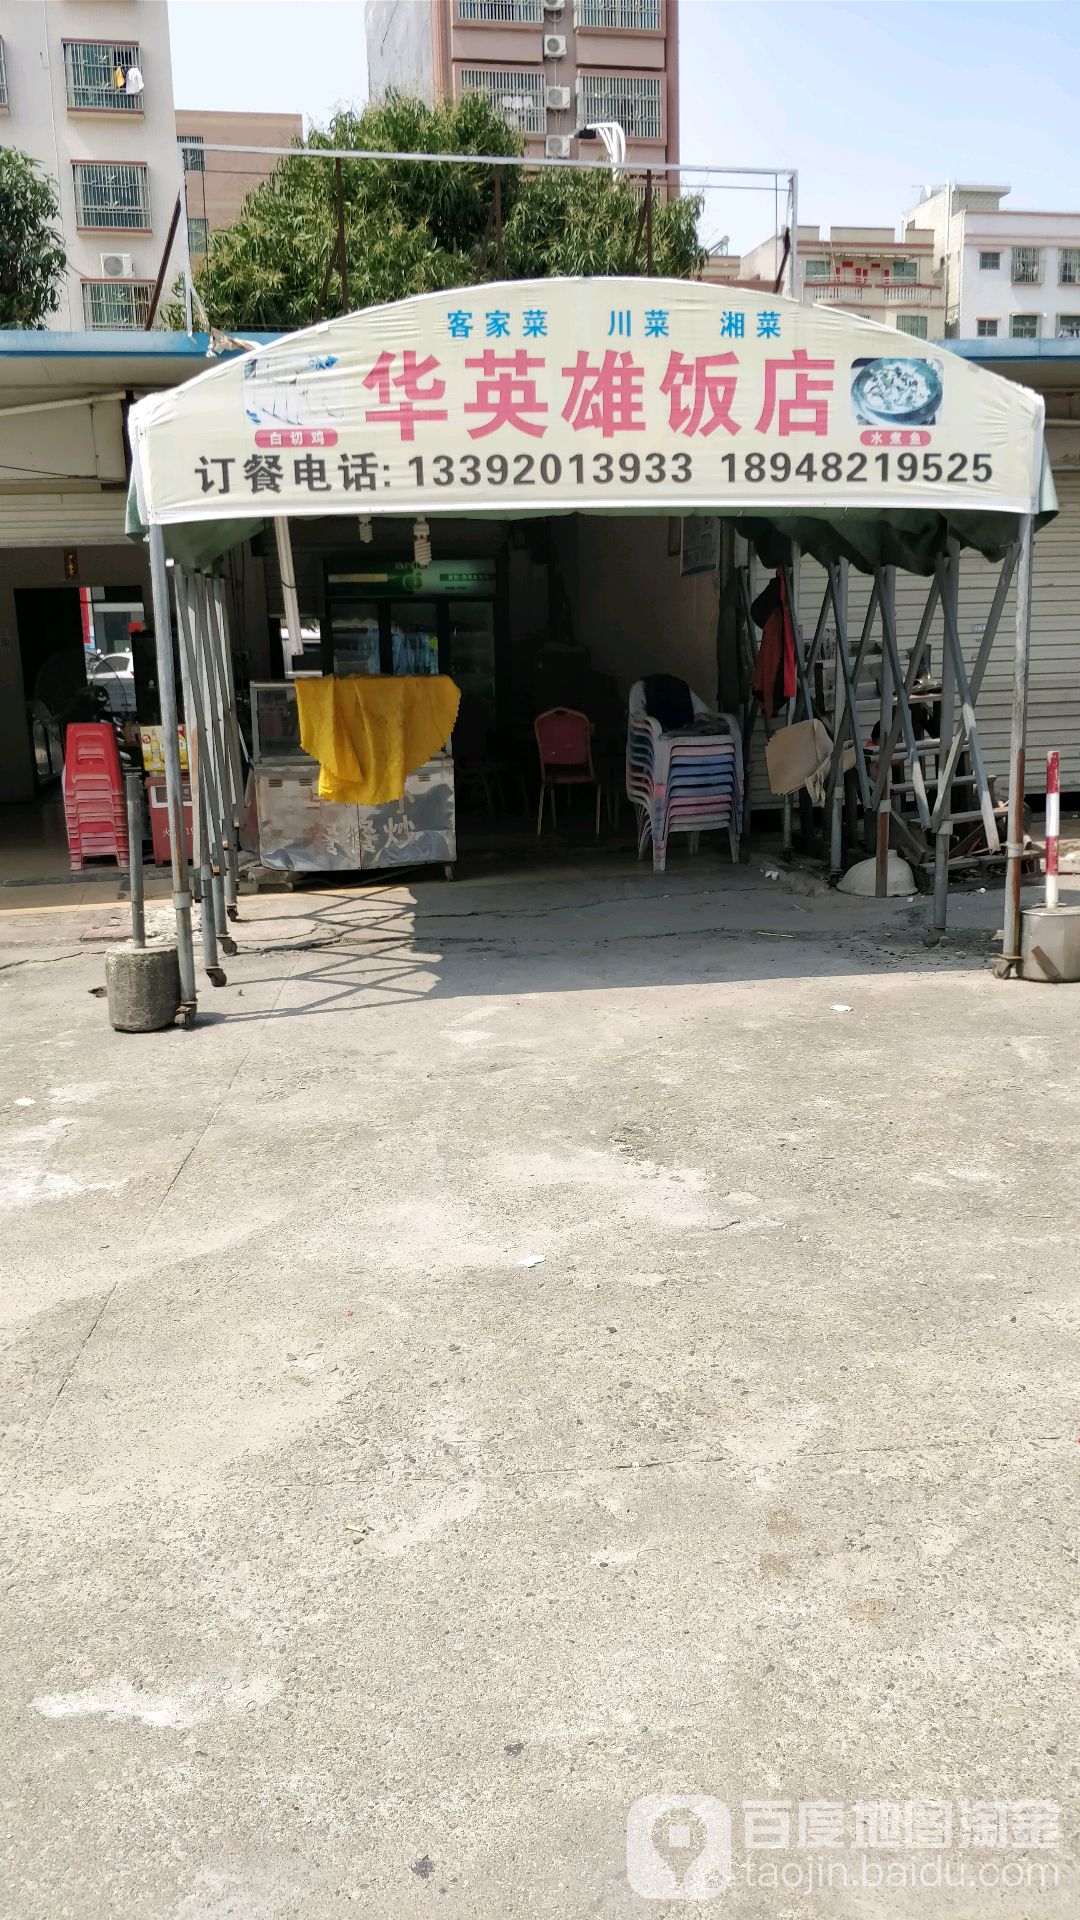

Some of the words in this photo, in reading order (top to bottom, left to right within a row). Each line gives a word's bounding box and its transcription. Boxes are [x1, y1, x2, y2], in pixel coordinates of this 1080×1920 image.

[447, 310, 549, 339] 客家菜
[607, 309, 671, 339] 川菜
[720, 309, 782, 338] 湘菜
[362, 348, 836, 442] 华英雄饭店
[269, 430, 326, 447] 白切鸡
[869, 431, 923, 446] 水煮鱼
[407, 453, 693, 487] 13392013933
[721, 453, 993, 484] 18948219525
